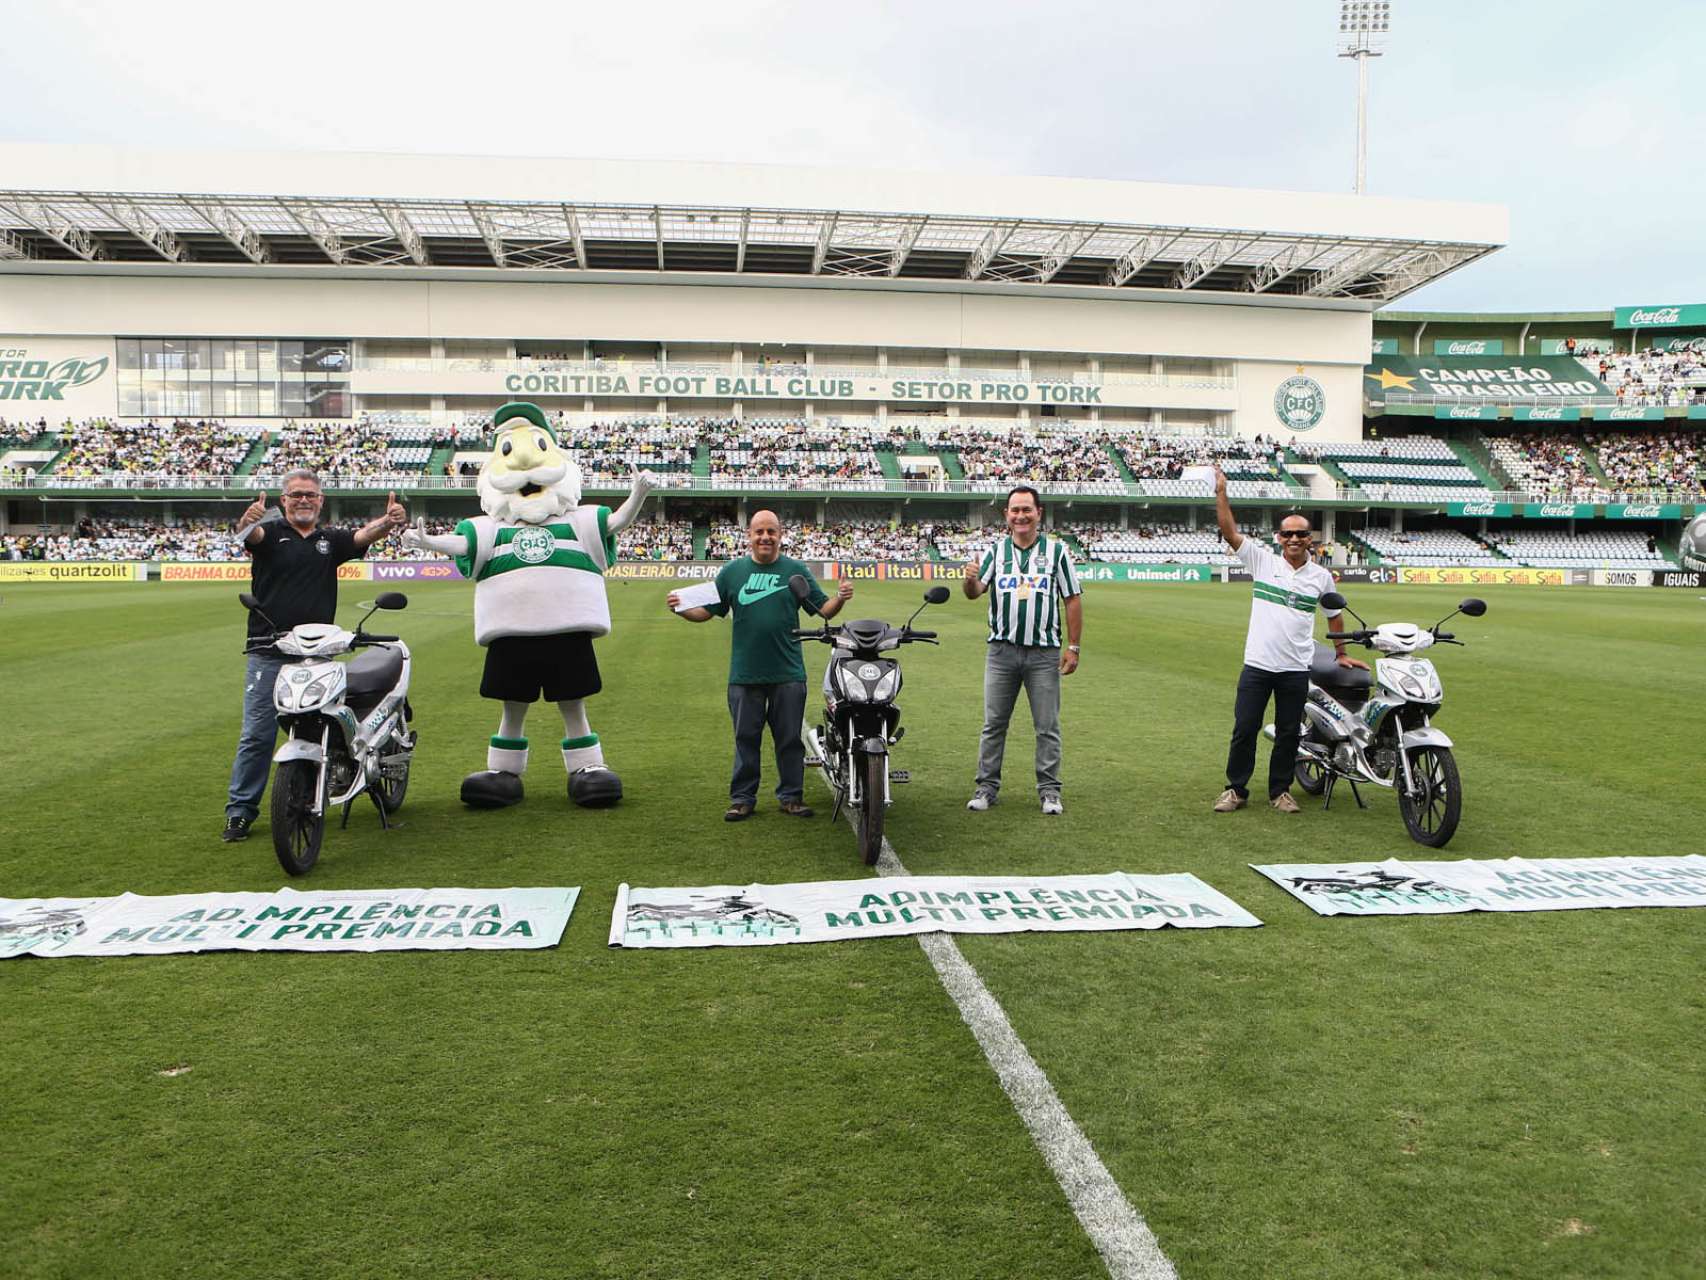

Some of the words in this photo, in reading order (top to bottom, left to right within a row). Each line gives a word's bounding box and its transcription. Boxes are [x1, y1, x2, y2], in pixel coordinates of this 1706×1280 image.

[1419, 366, 1552, 383] CAMPEÃO
[505, 374, 630, 393] CORITIBA
[639, 376, 707, 395] FOOT
[715, 378, 779, 396] BALL
[787, 379, 854, 397] CLUB
[891, 381, 972, 399] SETOR
[981, 383, 1029, 401] PRO
[1037, 384, 1101, 403] TORK
[1430, 381, 1597, 396] BRASILEIRO
[1286, 397, 1314, 411] CFC
[50, 564, 127, 578] quartzolit
[164, 567, 223, 579] BRAHMA
[604, 563, 674, 578] RASILEIRÃO
[887, 562, 921, 579] Itaú
[933, 563, 967, 579] Itaú
[1127, 569, 1180, 580] Unimed
[1605, 573, 1637, 584] SOMOS
[748, 573, 779, 590] NIKE
[1663, 573, 1700, 586] IGUAIS
[859, 888, 1166, 909] ADIMPLÊNCIA
[168, 902, 501, 924] ADMPLÊNCIA
[825, 907, 967, 927] MULTI
[979, 902, 1224, 921] PREMIADA
[271, 920, 533, 940] PREMIADA
